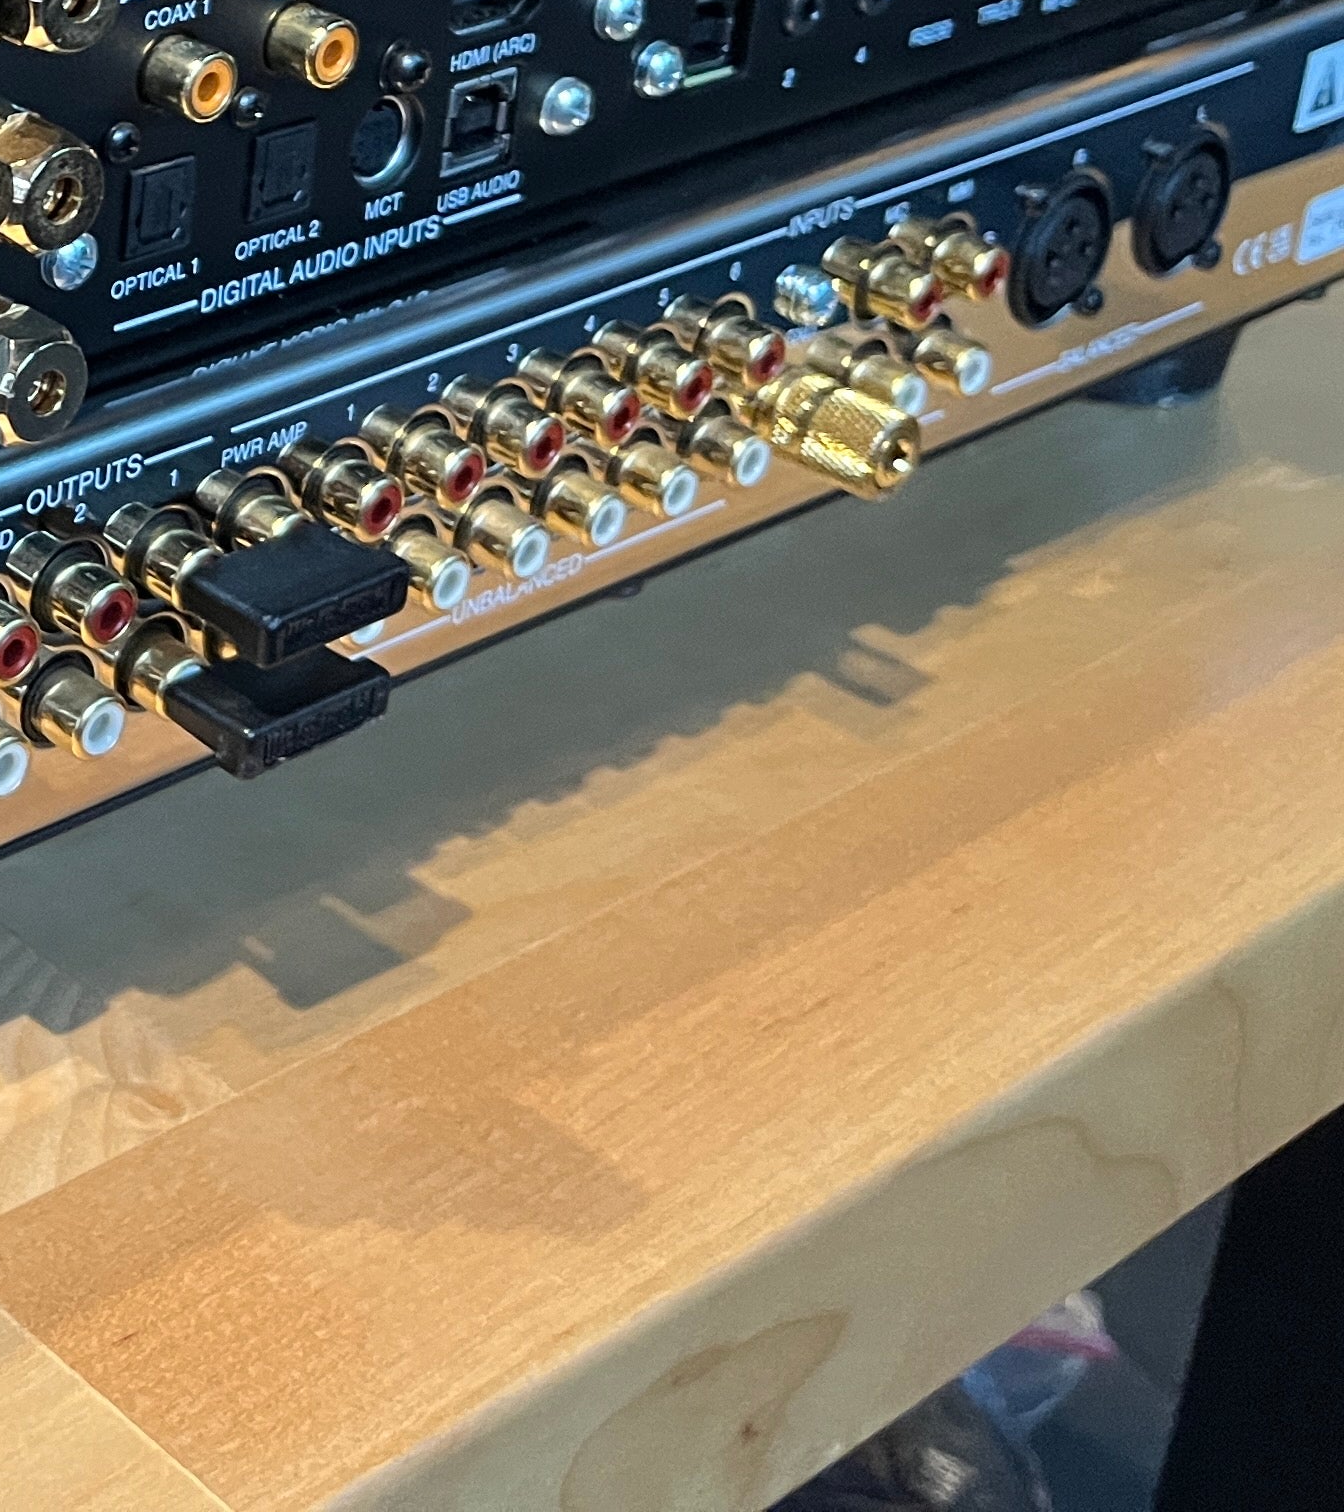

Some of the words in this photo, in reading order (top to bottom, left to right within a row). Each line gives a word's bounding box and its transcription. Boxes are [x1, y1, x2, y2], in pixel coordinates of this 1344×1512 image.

[144, 0, 196, 32] COAX
[450, 45, 491, 73] HDMI
[364, 190, 405, 221] MCT
[436, 186, 469, 214] USB
[470, 170, 522, 203] AUDIO
[235, 225, 306, 261] OPTICAL
[308, 218, 322, 239] 2
[111, 263, 187, 301] OPTICAL
[190, 256, 202, 276] 1
[200, 266, 287, 315] DIGITAL
[288, 240, 361, 286] AUDIO
[362, 214, 443, 261] INPUTS
[346, 403, 357, 423] 1
[427, 372, 442, 393] 2
[220, 435, 264, 468] PWR
[265, 420, 309, 455] AMP
[25, 453, 144, 516] OUTPUTS
[73, 502, 88, 525] 2
[168, 469, 179, 487] 1
[451, 553, 585, 625] UNBALANCED
